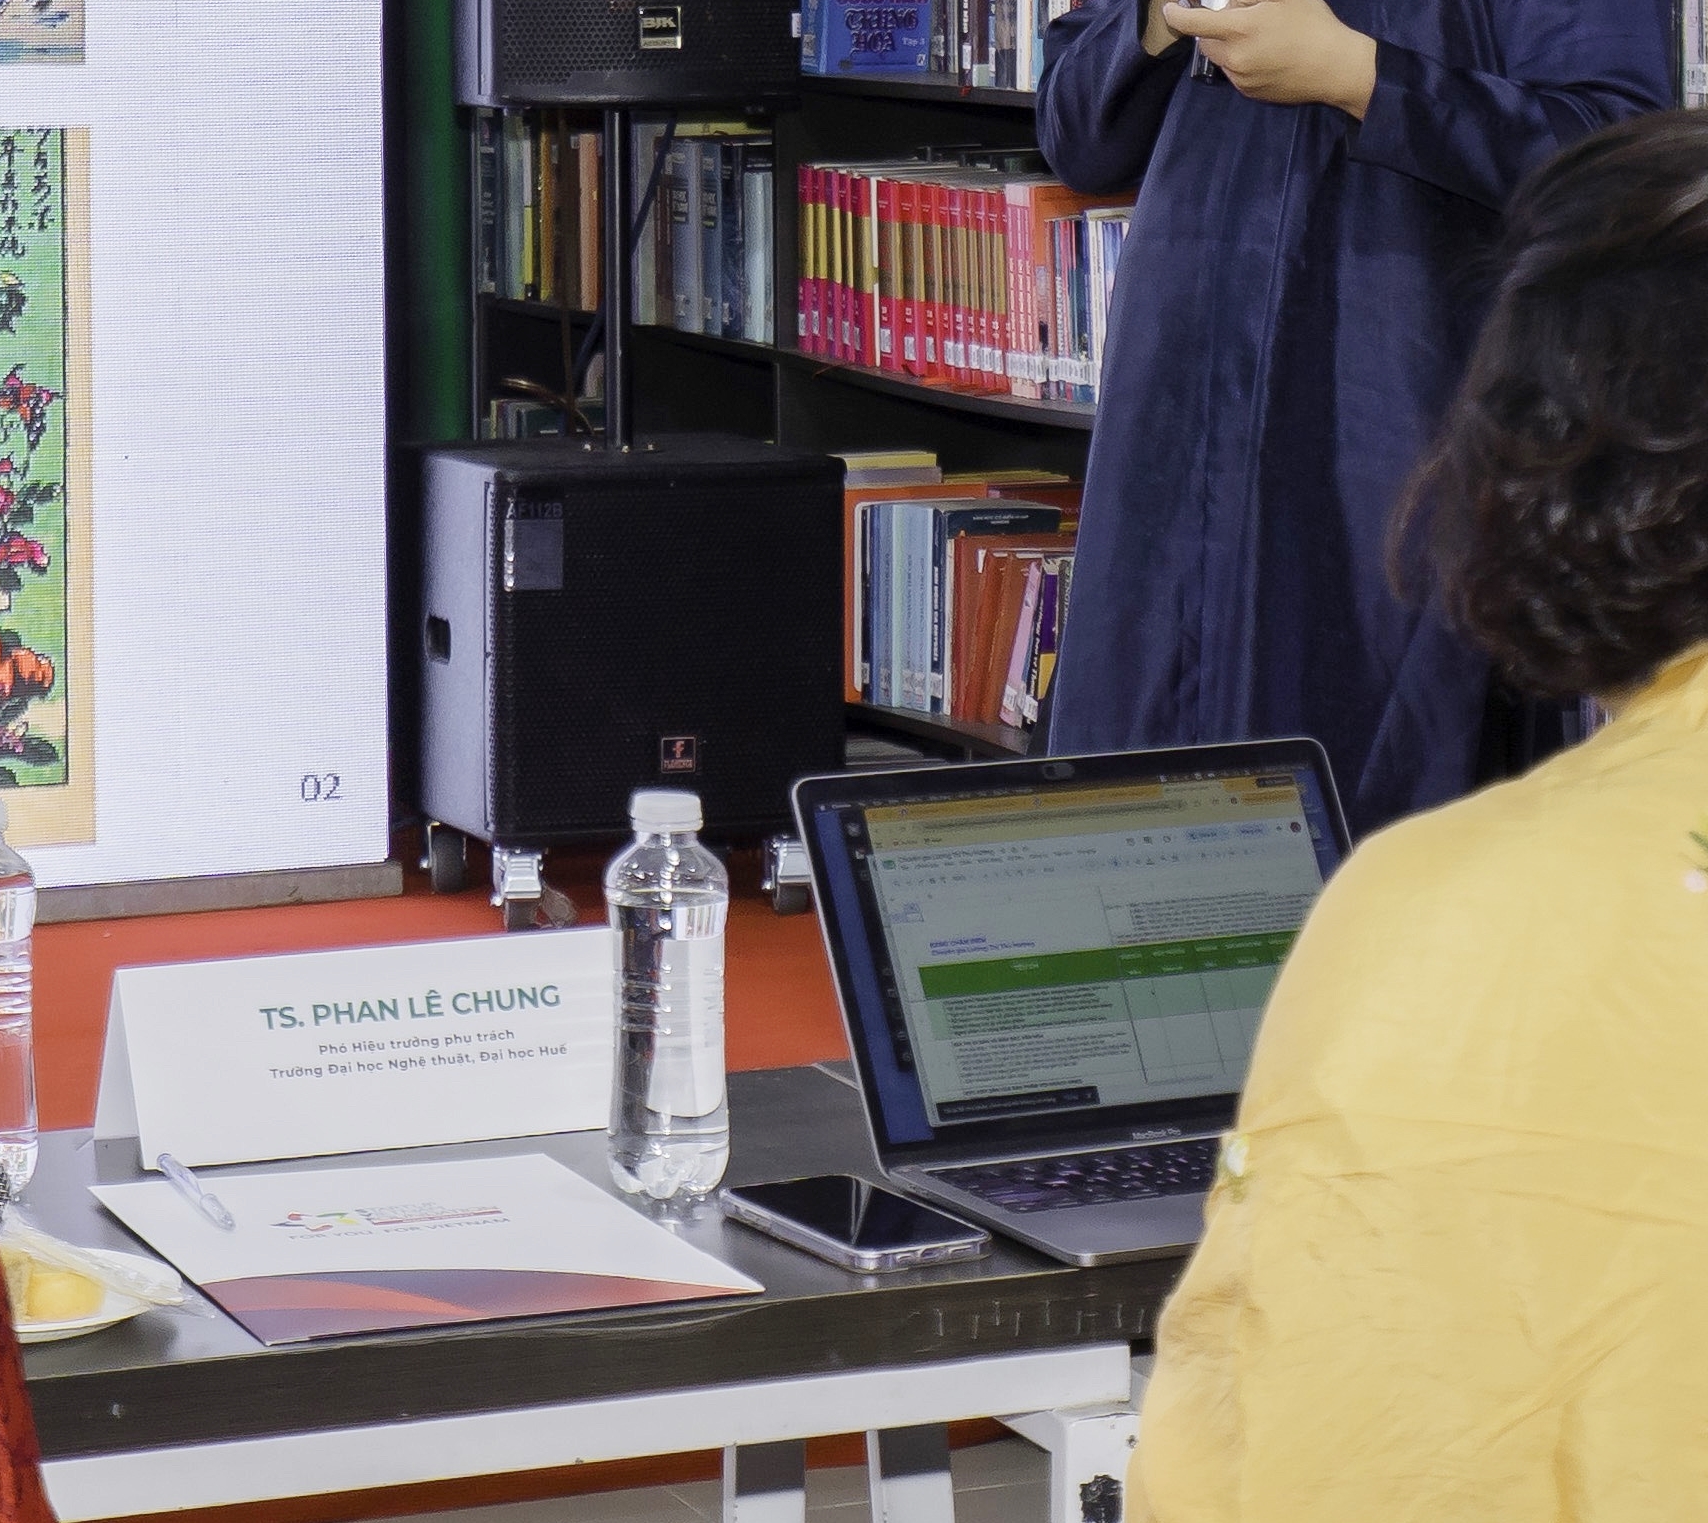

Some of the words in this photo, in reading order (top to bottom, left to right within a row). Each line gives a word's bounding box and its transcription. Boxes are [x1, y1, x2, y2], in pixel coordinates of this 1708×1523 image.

[301, 772, 342, 802] 02
[259, 1006, 305, 1030] TS.
[312, 998, 400, 1027] PHAN
[408, 990, 444, 1019] LÊ
[451, 984, 561, 1015] CHUNG
[318, 1042, 348, 1056] Phó
[352, 1039, 385, 1055] Hiệu
[390, 1035, 440, 1052] trưởng
[444, 1031, 473, 1049] phụ
[476, 1029, 515, 1043] trách
[269, 1065, 323, 1080] Trường
[327, 1061, 353, 1076] Đại
[357, 1059, 384, 1073] học
[388, 1055, 427, 1072] Nghệ
[431, 1052, 476, 1067] thuật,
[479, 1049, 504, 1064] Đại
[508, 1046, 535, 1061] học
[539, 1042, 568, 1056] Huế
